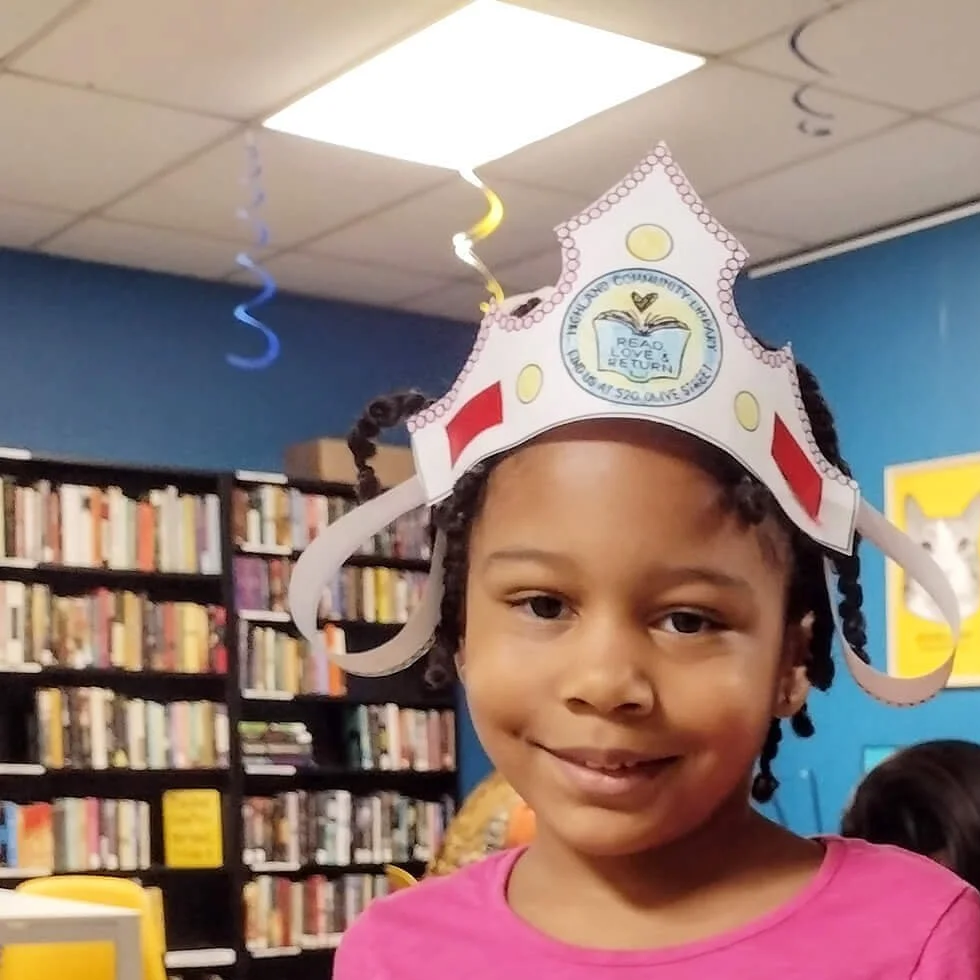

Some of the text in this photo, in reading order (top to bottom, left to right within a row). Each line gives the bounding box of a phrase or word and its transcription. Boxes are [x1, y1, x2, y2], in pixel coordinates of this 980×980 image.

[566, 270, 717, 351] HIGHLAND COMMUNITY LIBRARY
[610, 347, 654, 361] LOVE
[607, 357, 673, 374] RETURN
